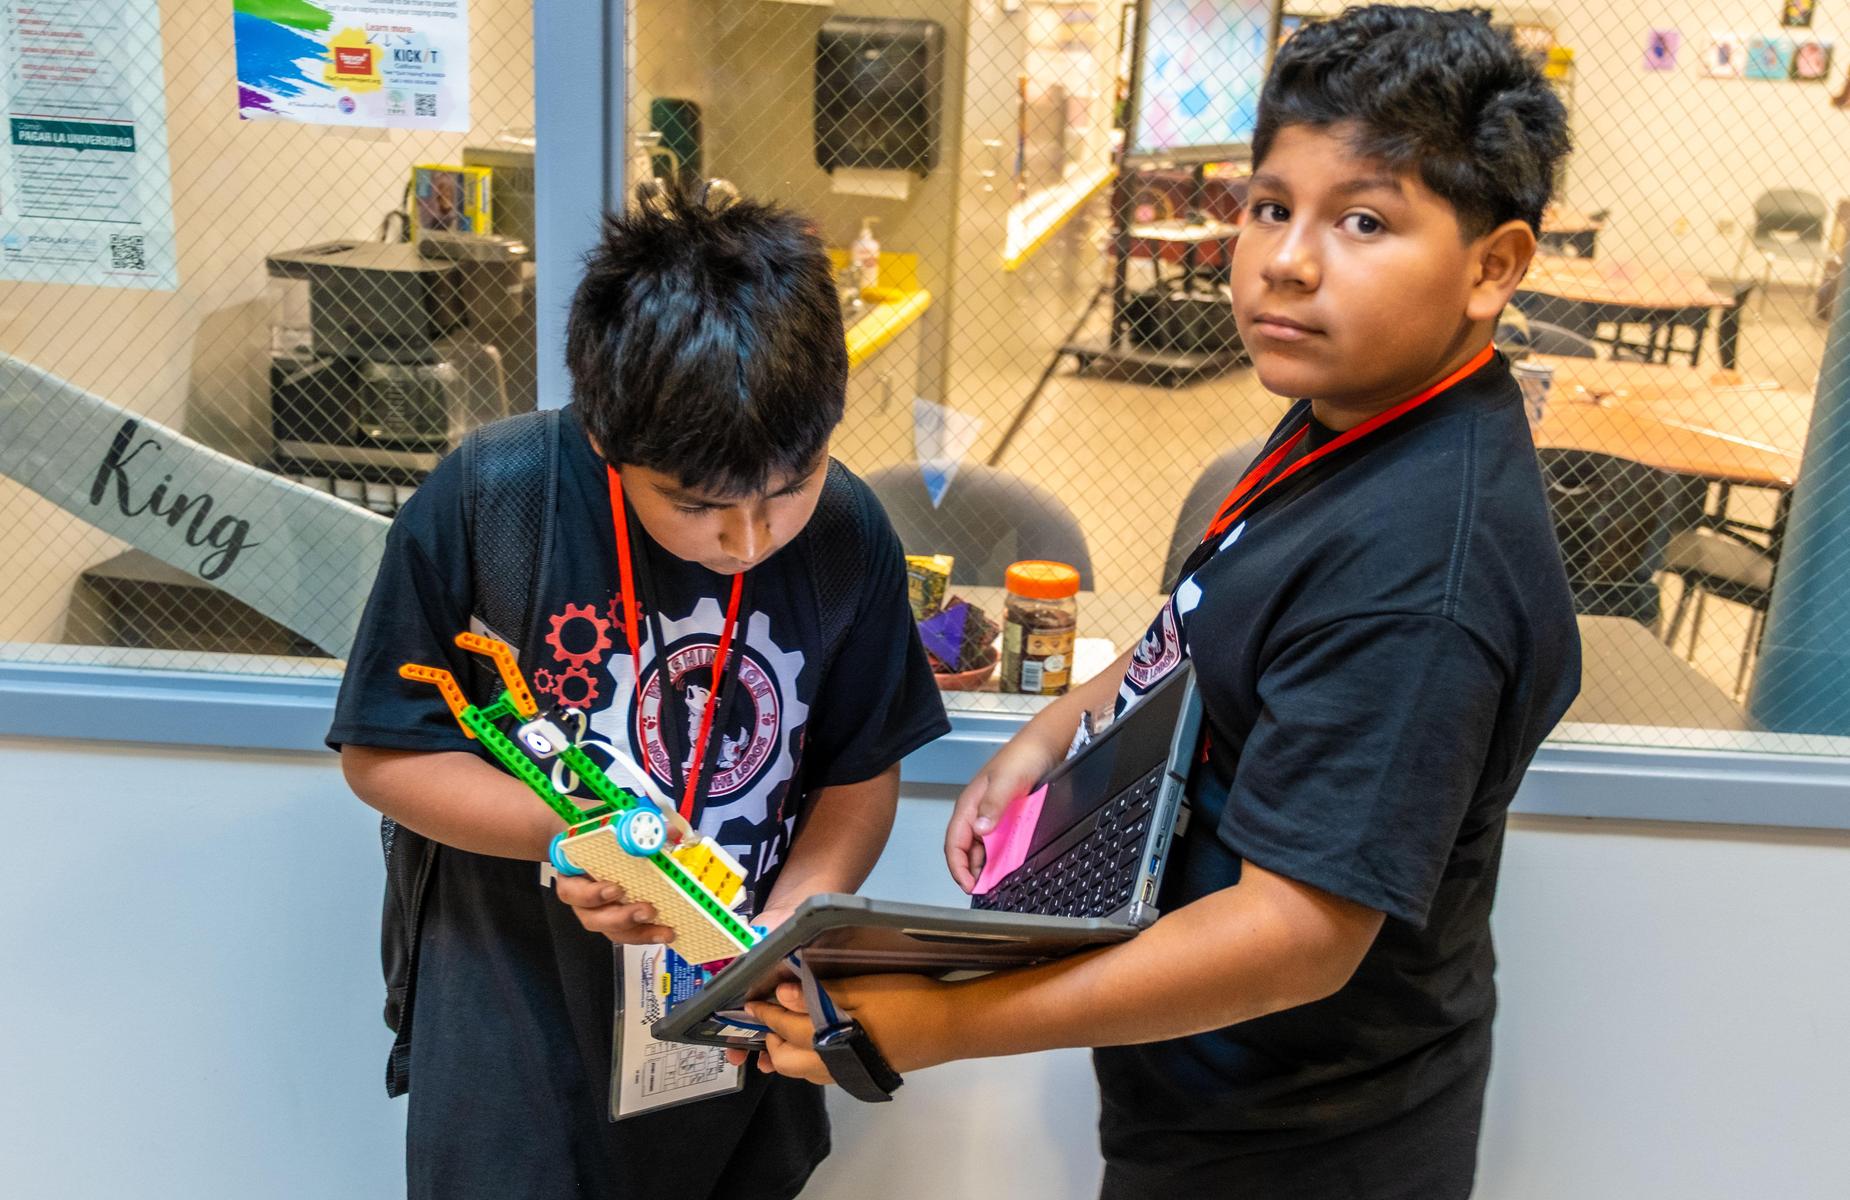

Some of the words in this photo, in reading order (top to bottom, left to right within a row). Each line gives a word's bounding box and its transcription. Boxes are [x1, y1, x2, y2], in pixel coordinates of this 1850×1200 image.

[365, 23, 389, 32] Learn
[393, 48, 422, 63] KICK
[18, 130, 52, 142] PAGAR
[53, 133, 66, 143] LA
[66, 134, 133, 148] UNIVERSIDAD
[90, 419, 260, 581] King
[647, 740, 673, 777] HOM
[735, 736, 768, 779] LOBOS
